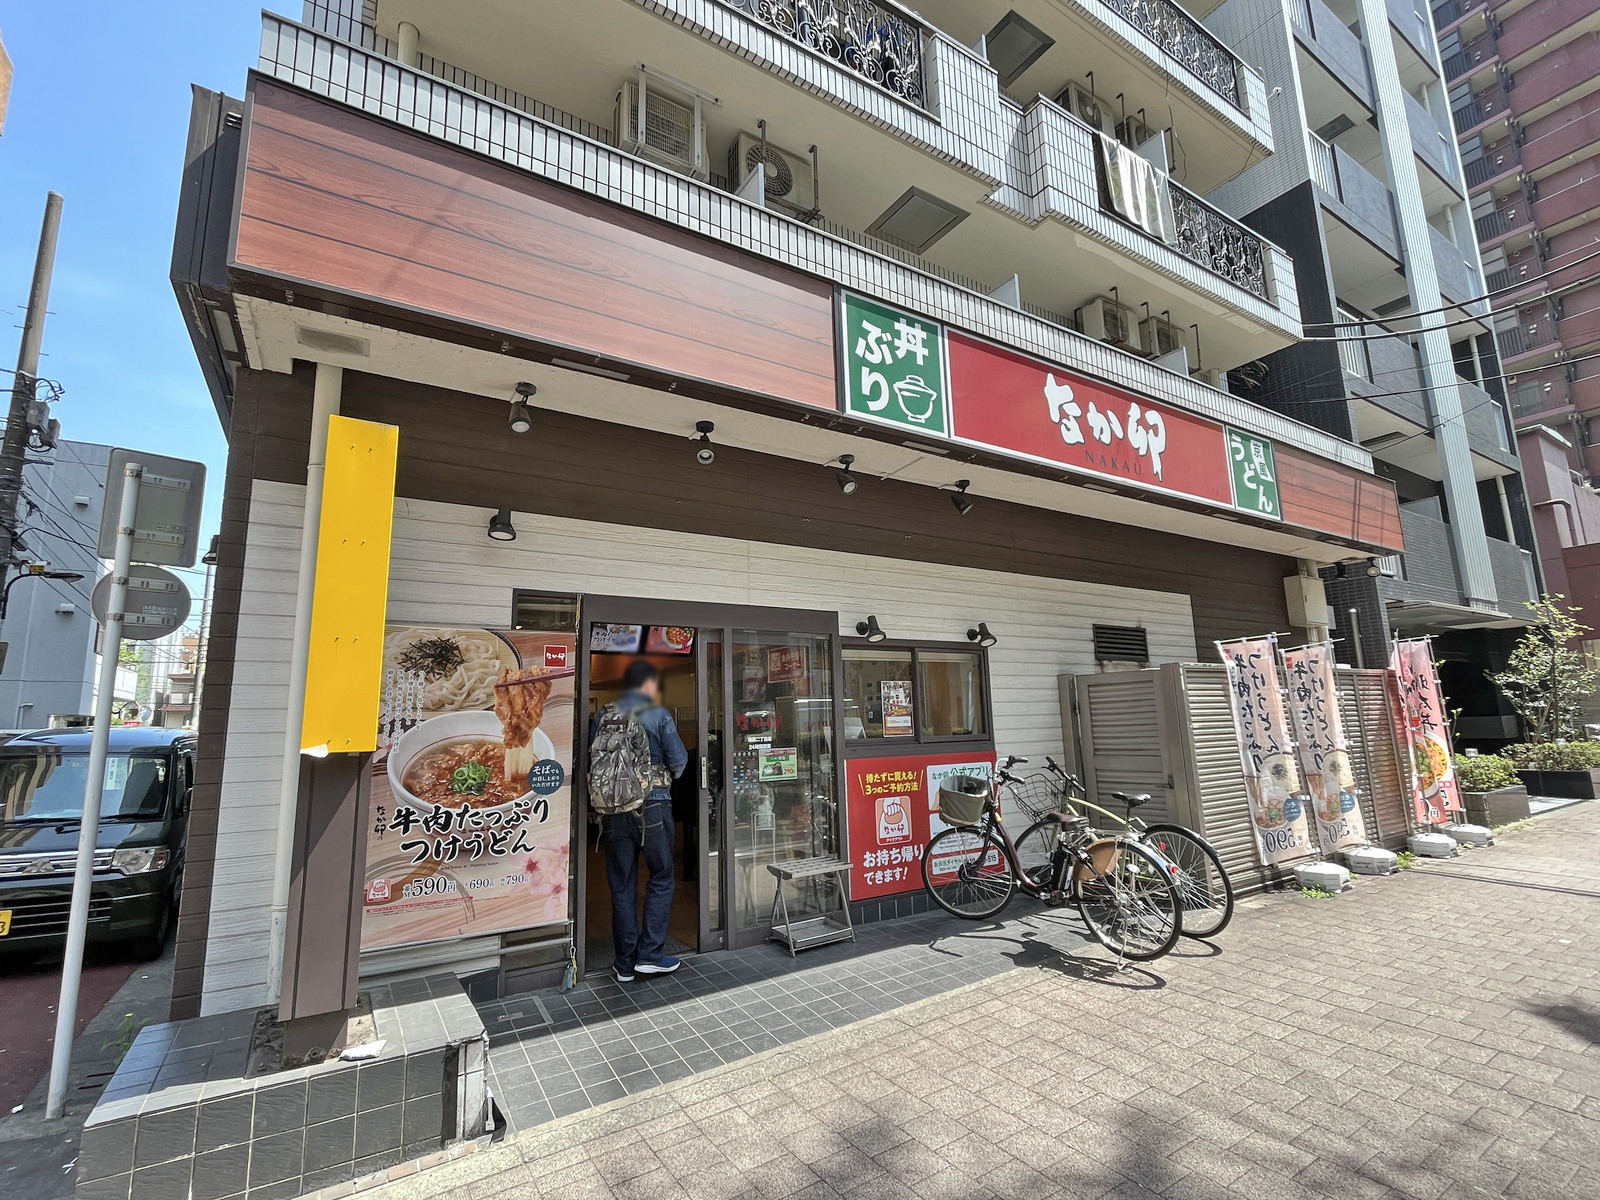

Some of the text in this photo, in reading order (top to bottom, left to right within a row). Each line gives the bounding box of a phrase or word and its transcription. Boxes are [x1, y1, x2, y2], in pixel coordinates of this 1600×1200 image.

[1044, 373, 1167, 482] なか卯
[1085, 450, 1141, 475] NAKAU
[1231, 433, 1273, 512] うどん
[533, 765, 560, 774] そばでも
[866, 771, 917, 783] 待たずに買える!
[865, 782, 918, 795] 3つのご予約方法
[389, 799, 549, 835] 牛肉たっぷり
[400, 829, 536, 863] つけうどん
[863, 843, 924, 868] お持ち帰り
[864, 866, 908, 885] できます!
